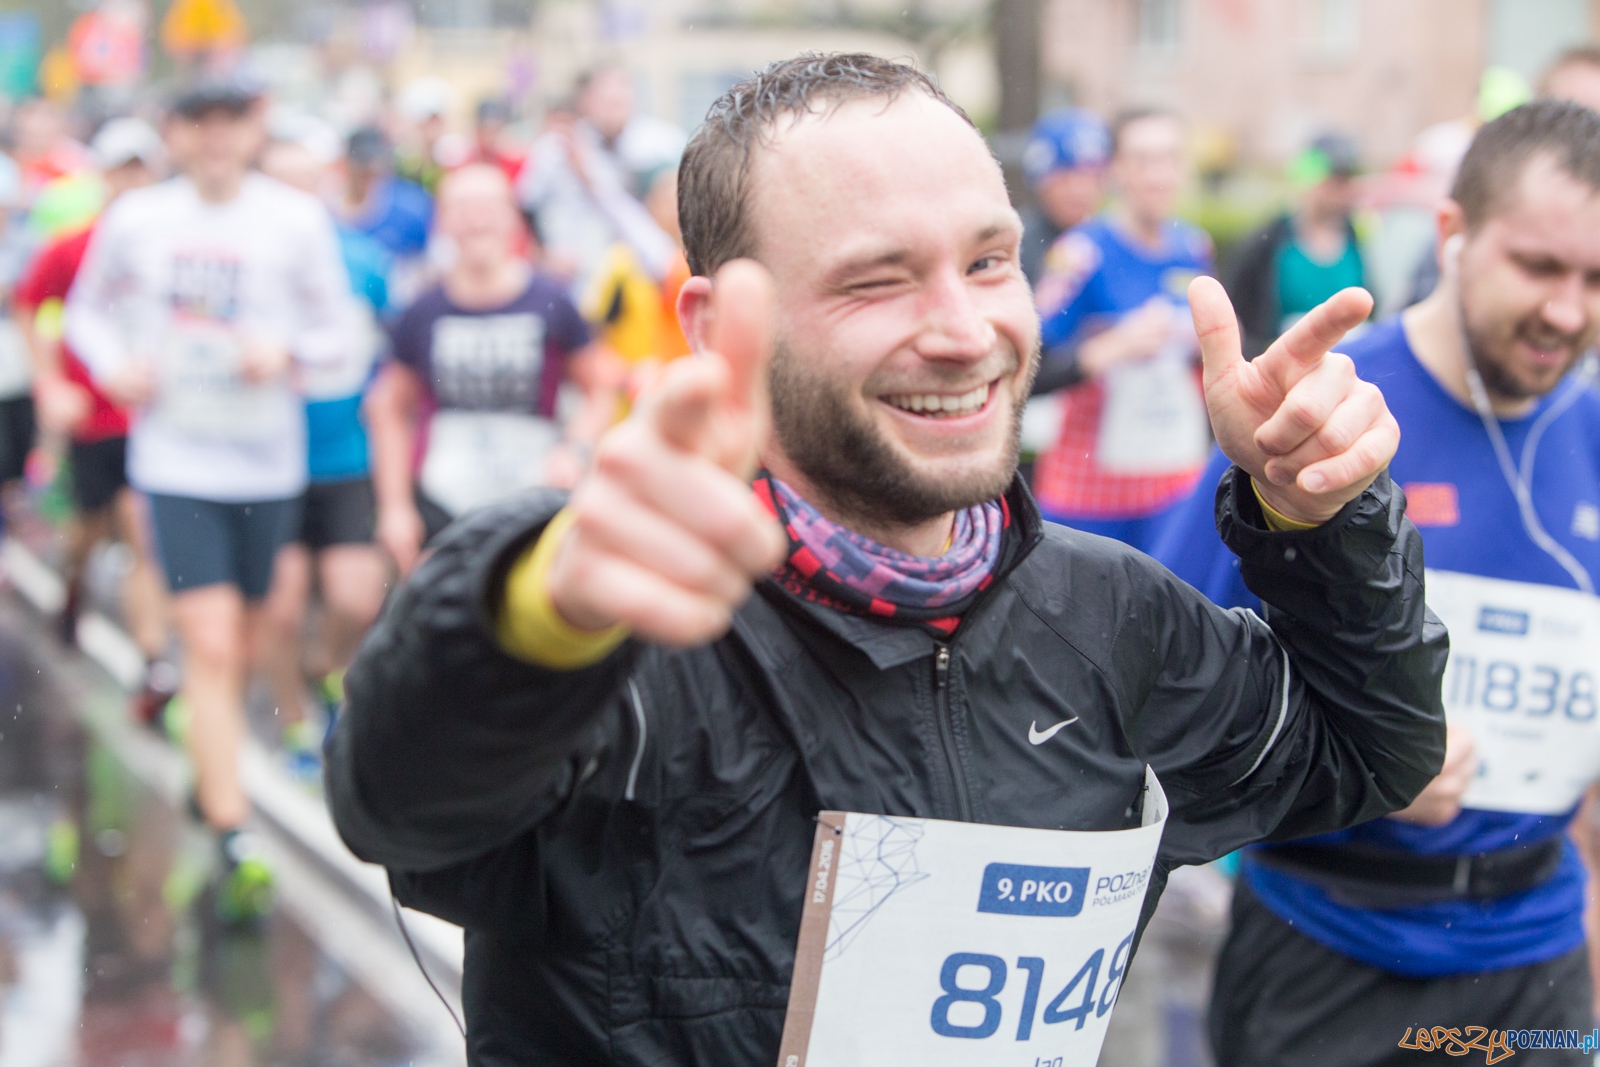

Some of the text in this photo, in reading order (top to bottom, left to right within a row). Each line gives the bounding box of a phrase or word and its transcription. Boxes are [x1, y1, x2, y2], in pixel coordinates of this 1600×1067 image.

[1451, 655, 1597, 722] 11838
[1020, 879, 1073, 904] PKO
[930, 930, 1135, 1042] 8148
